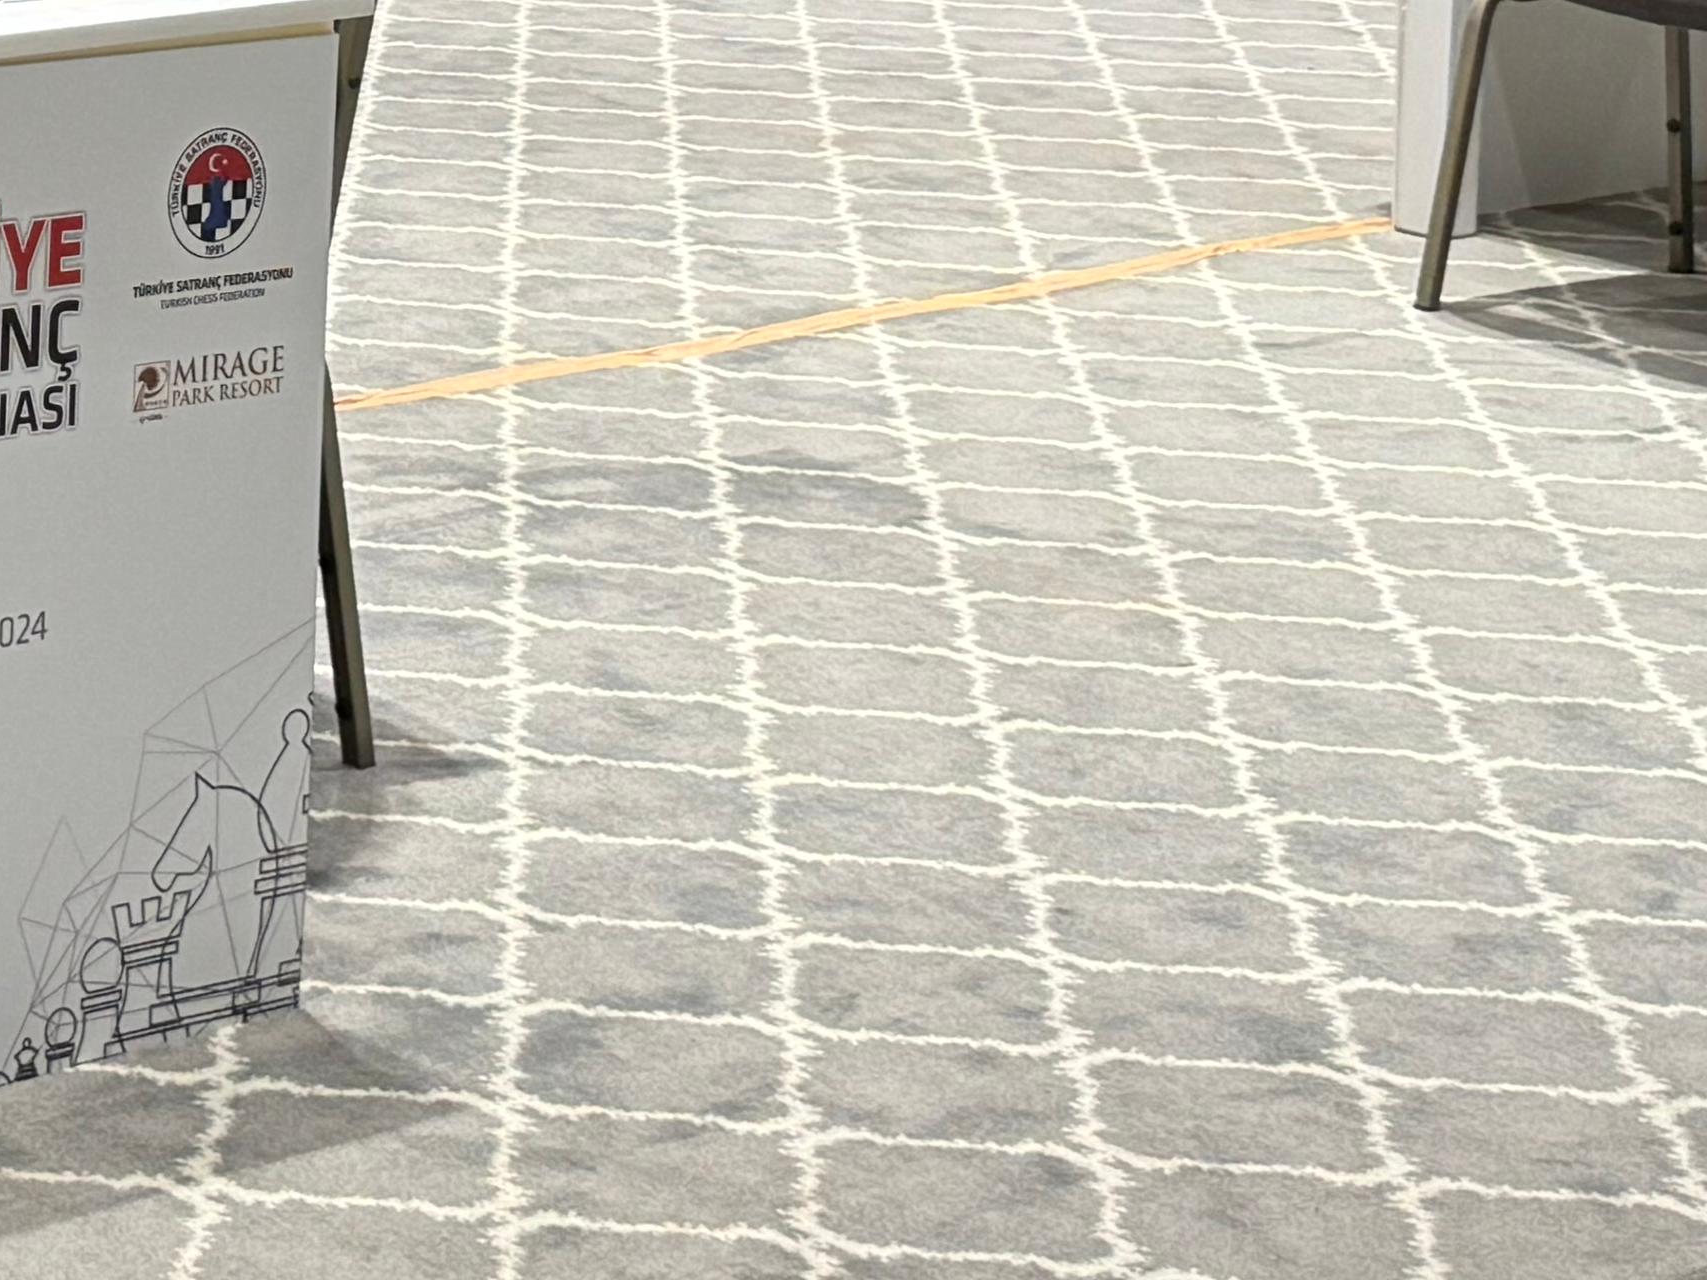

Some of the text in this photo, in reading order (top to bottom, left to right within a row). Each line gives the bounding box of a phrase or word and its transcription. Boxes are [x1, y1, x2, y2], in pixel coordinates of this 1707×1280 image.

[133, 267, 294, 298] TÜRKİYE SATRANÇ FEDERASYONU
[173, 345, 285, 386] MIRAGE
[172, 376, 285, 407] PARK RESORT
